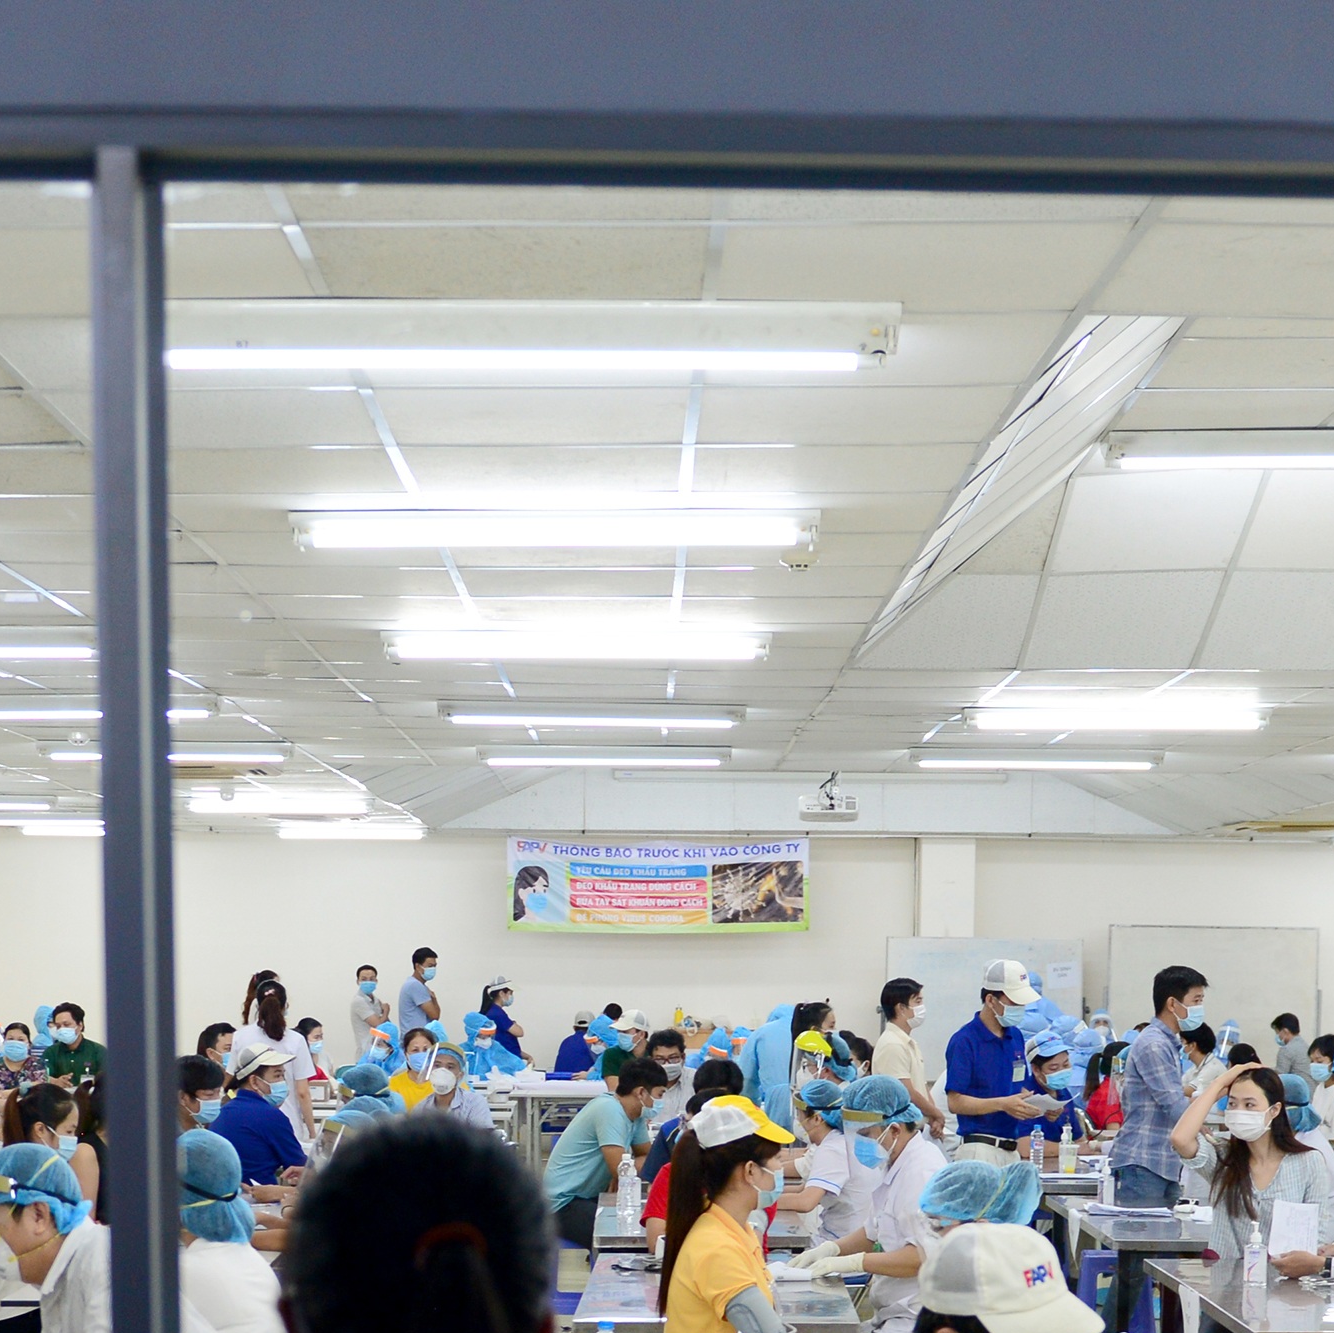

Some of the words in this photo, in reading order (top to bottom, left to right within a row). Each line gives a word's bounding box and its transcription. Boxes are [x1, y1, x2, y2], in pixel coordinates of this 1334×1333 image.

[553, 843, 601, 858] THÔNG
[683, 848, 706, 858] KHI
[786, 843, 800, 853] TY
[658, 867, 687, 877] TRANG
[620, 881, 648, 891] TRANG
[595, 897, 610, 906] TAY
